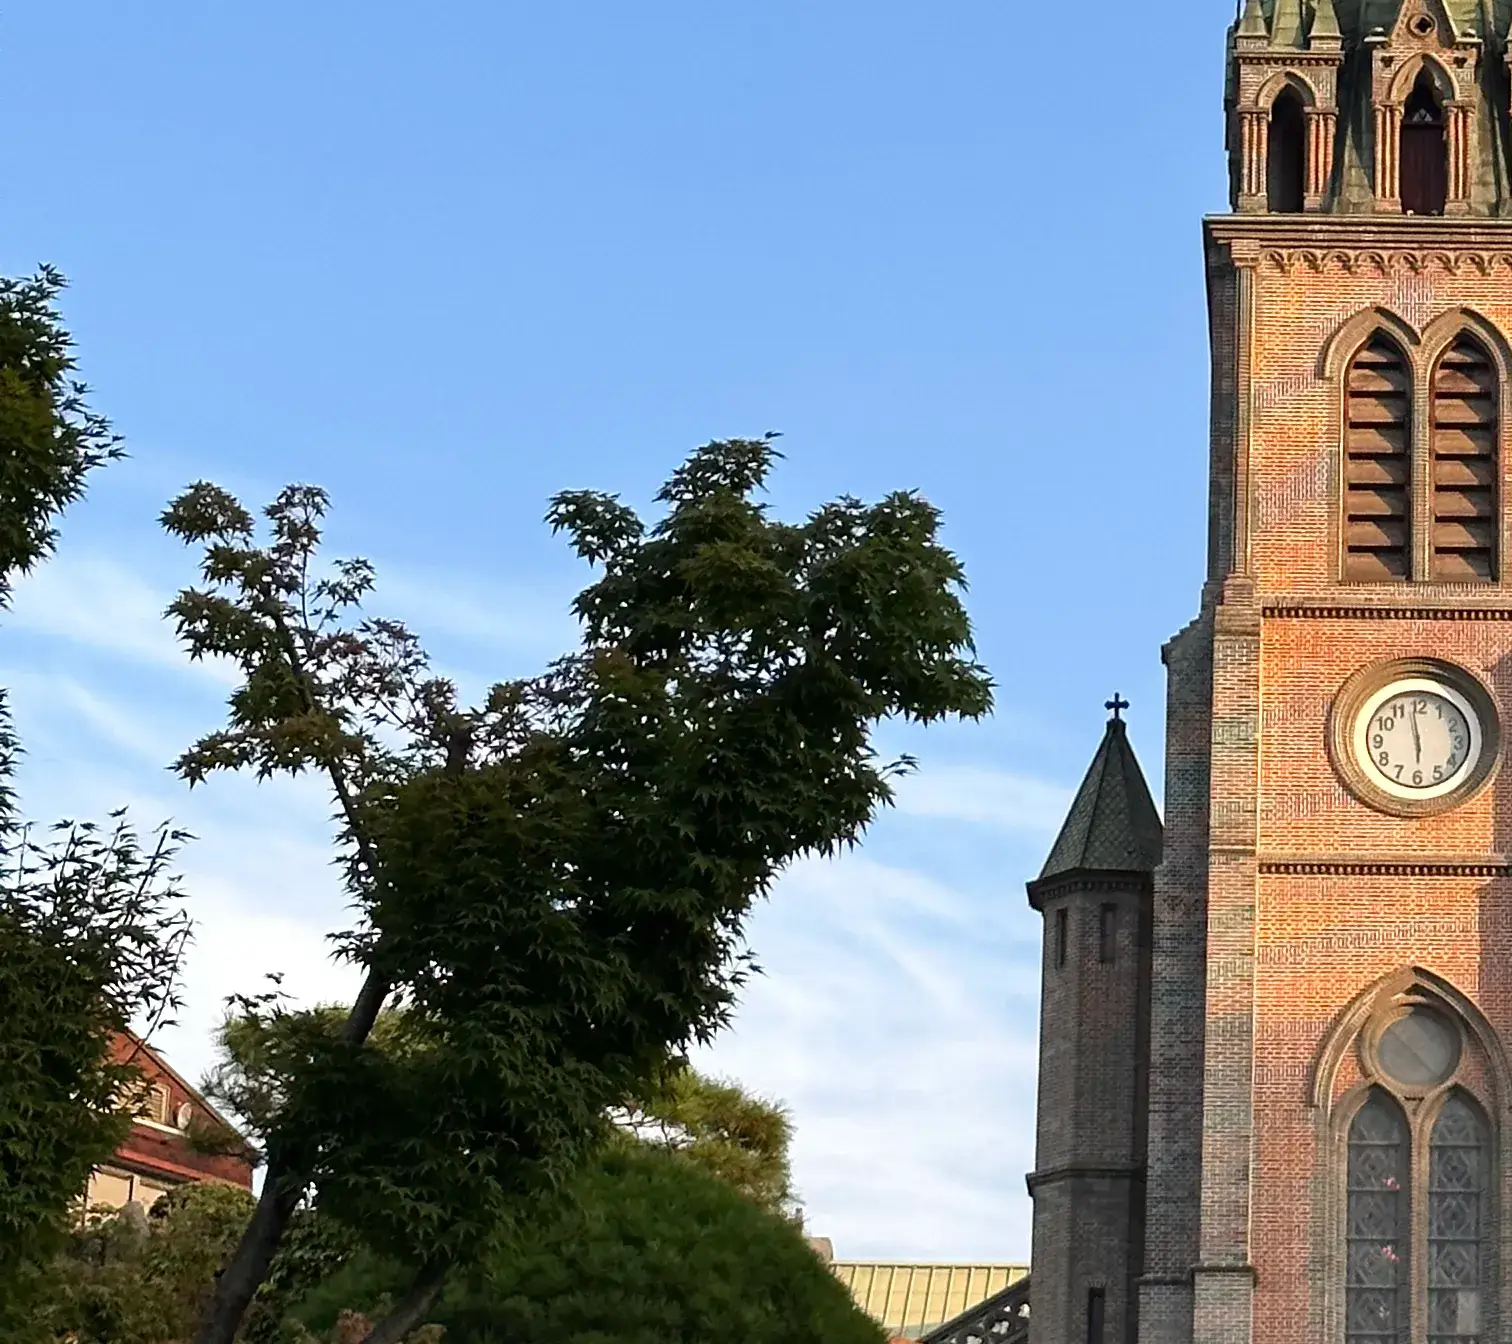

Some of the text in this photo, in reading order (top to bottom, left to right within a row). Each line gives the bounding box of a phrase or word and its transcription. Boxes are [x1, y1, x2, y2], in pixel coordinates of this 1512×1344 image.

[1390, 704, 1405, 719] 11
[1411, 699, 1428, 715] 12
[1435, 704, 1443, 720] 1
[1376, 716, 1394, 731] 10
[1448, 717, 1458, 733] 2
[1372, 734, 1384, 749] 9
[1453, 734, 1464, 751] 3
[1378, 751, 1390, 767] 8
[1446, 752, 1458, 769] 4
[1394, 764, 1405, 779] 7
[1412, 770, 1423, 785] 6
[1432, 765, 1444, 781] 5
